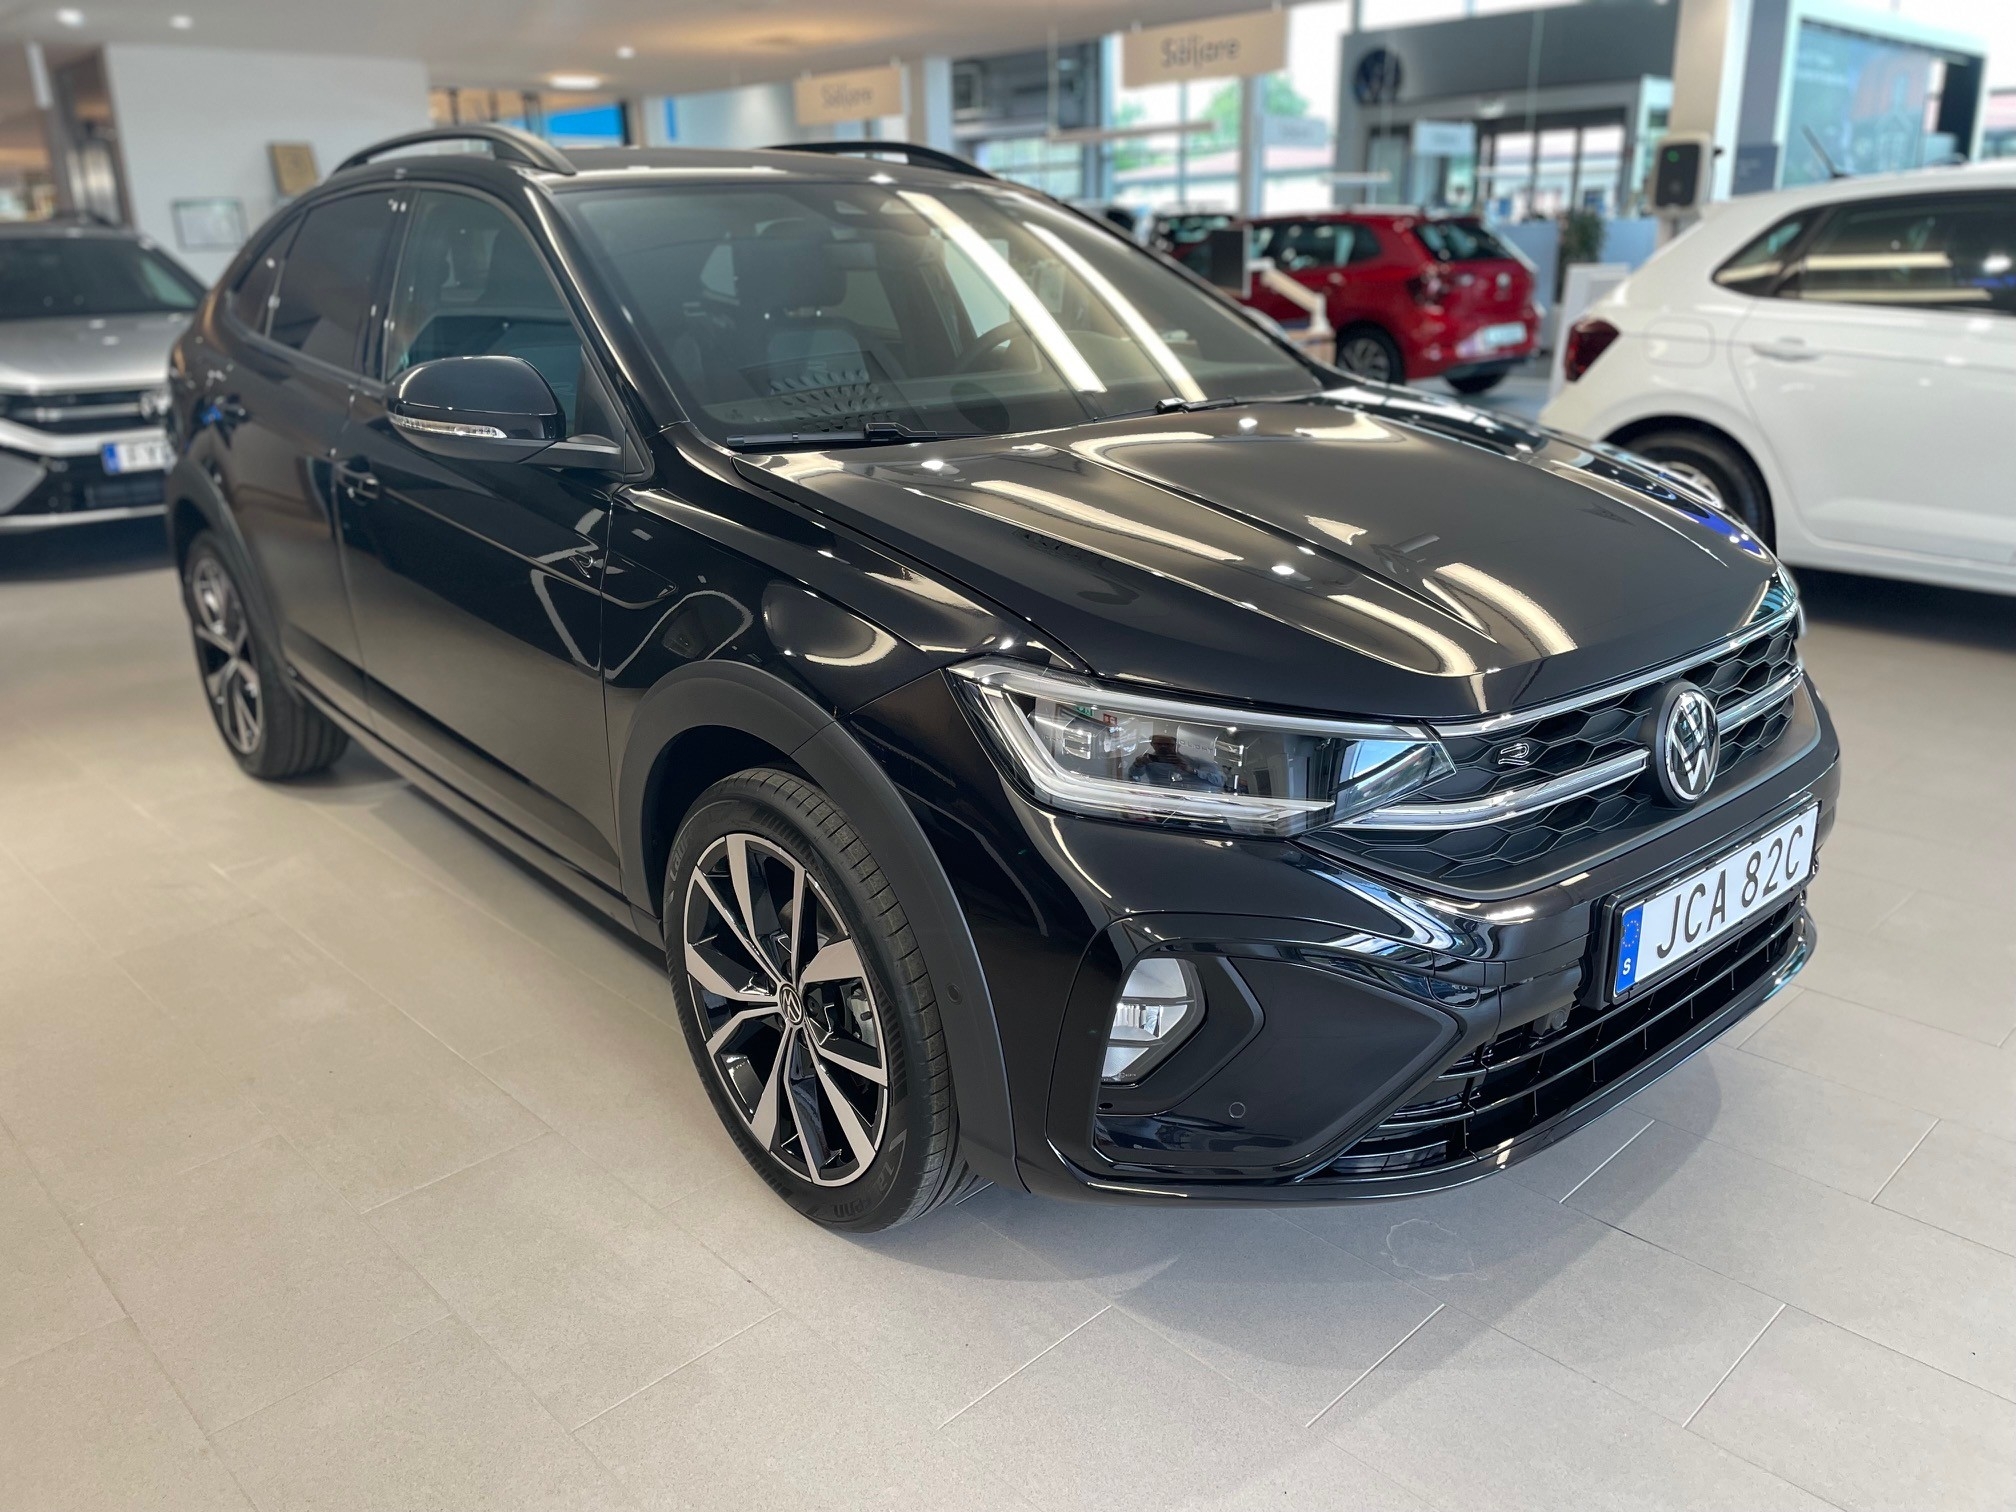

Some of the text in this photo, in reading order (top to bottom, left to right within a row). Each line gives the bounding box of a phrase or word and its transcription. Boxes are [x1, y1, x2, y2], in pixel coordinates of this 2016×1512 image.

[1656, 824, 1804, 959] JCA 82C
[1621, 957, 1631, 976] S
